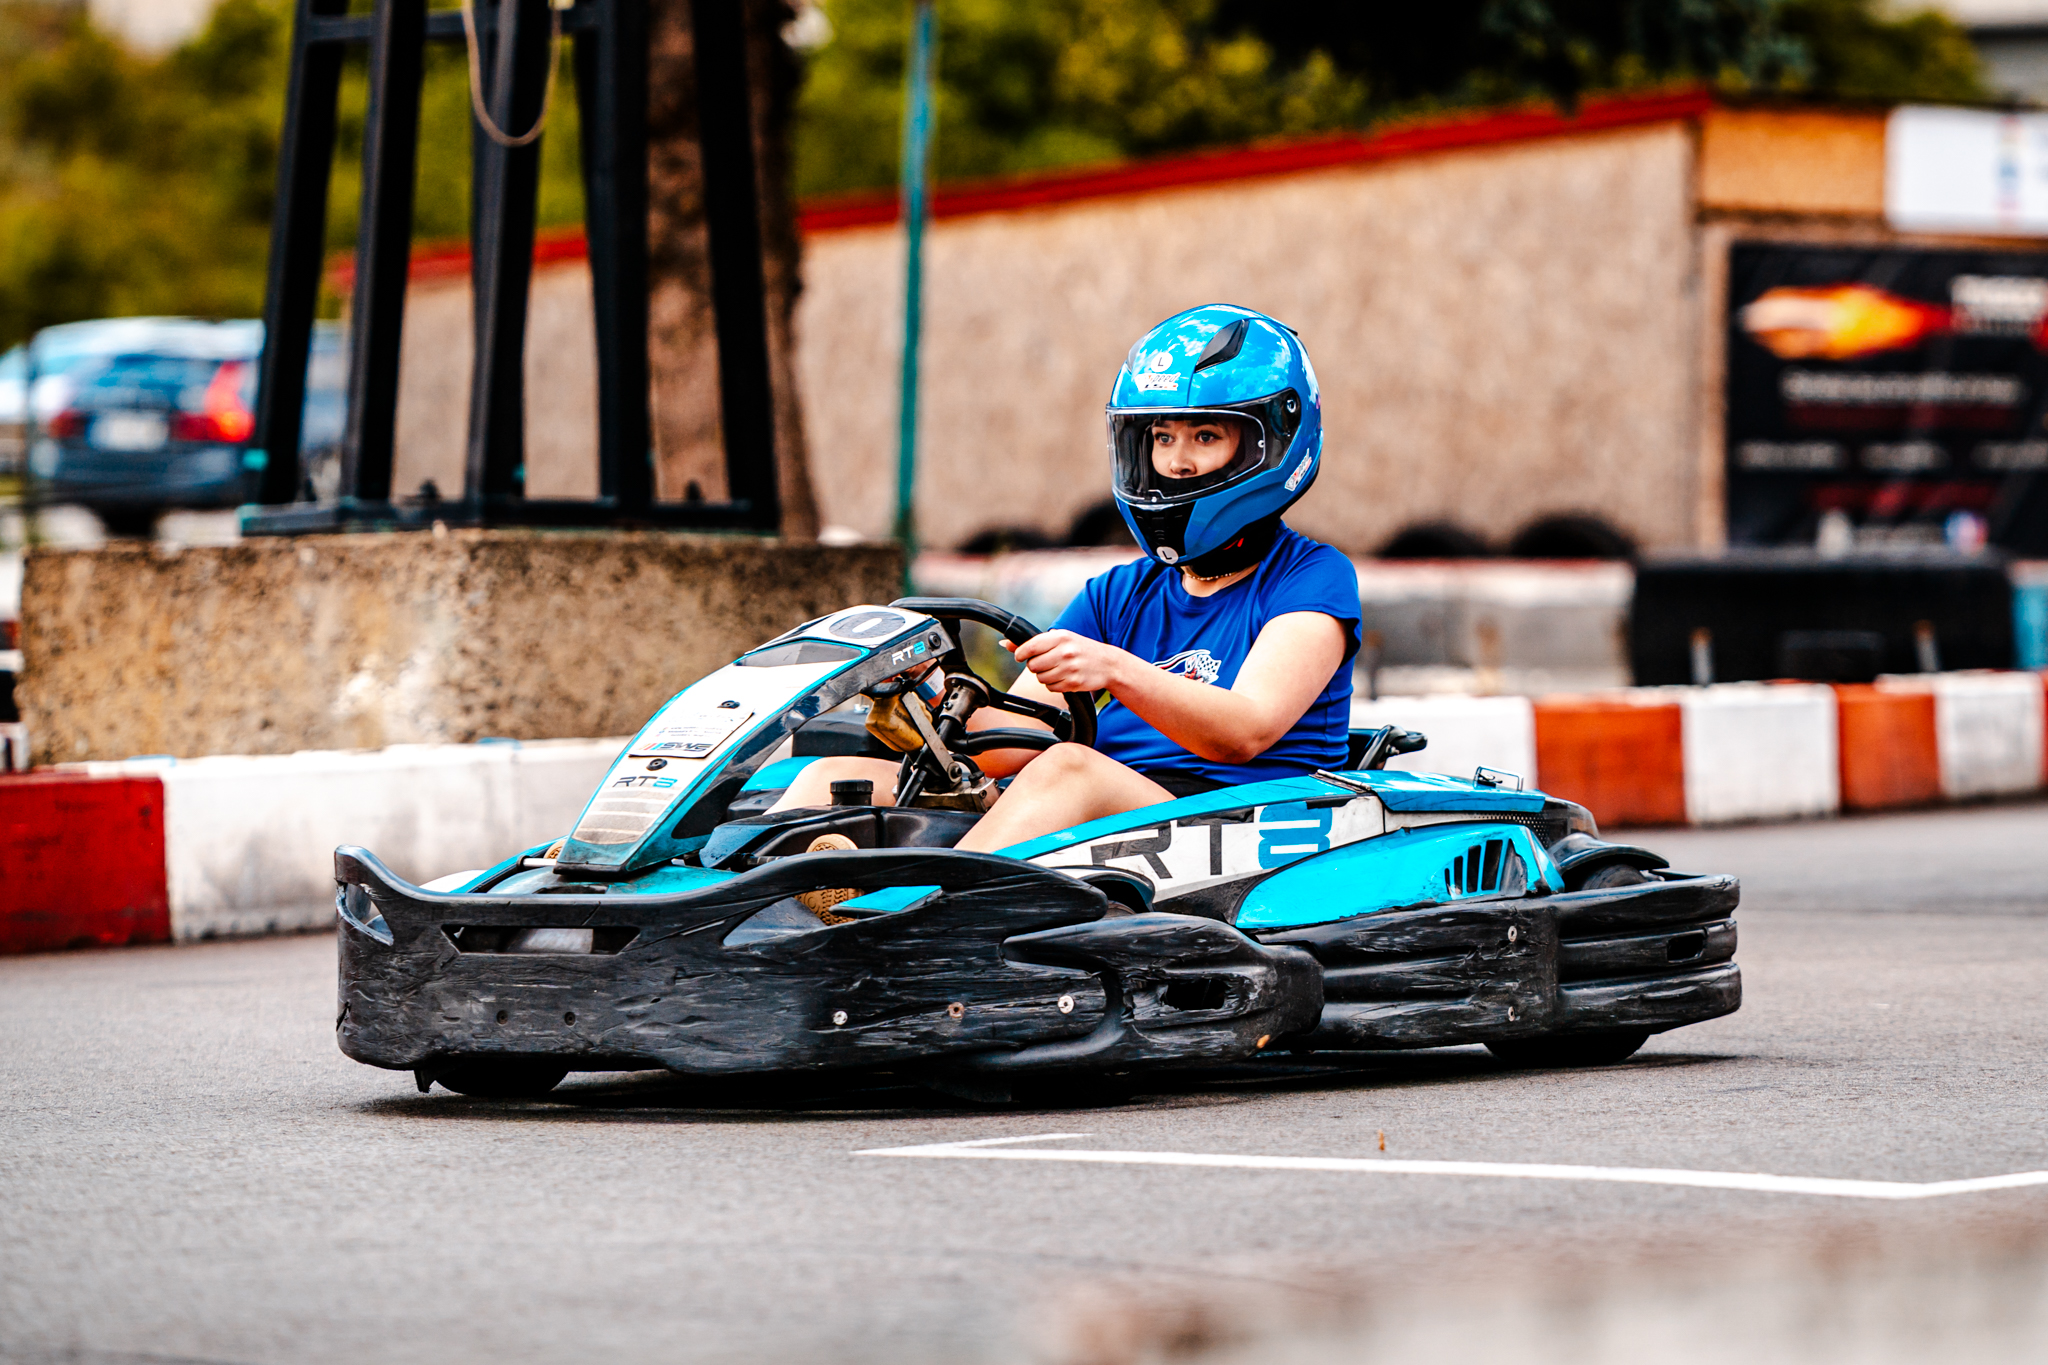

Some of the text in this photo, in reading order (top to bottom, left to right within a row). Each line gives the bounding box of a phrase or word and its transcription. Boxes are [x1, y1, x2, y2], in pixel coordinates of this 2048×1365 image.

[1162, 550, 1173, 560] L
[892, 641, 926, 665] RT8
[612, 775, 679, 788] RT8
[1090, 802, 1333, 880] RT8
